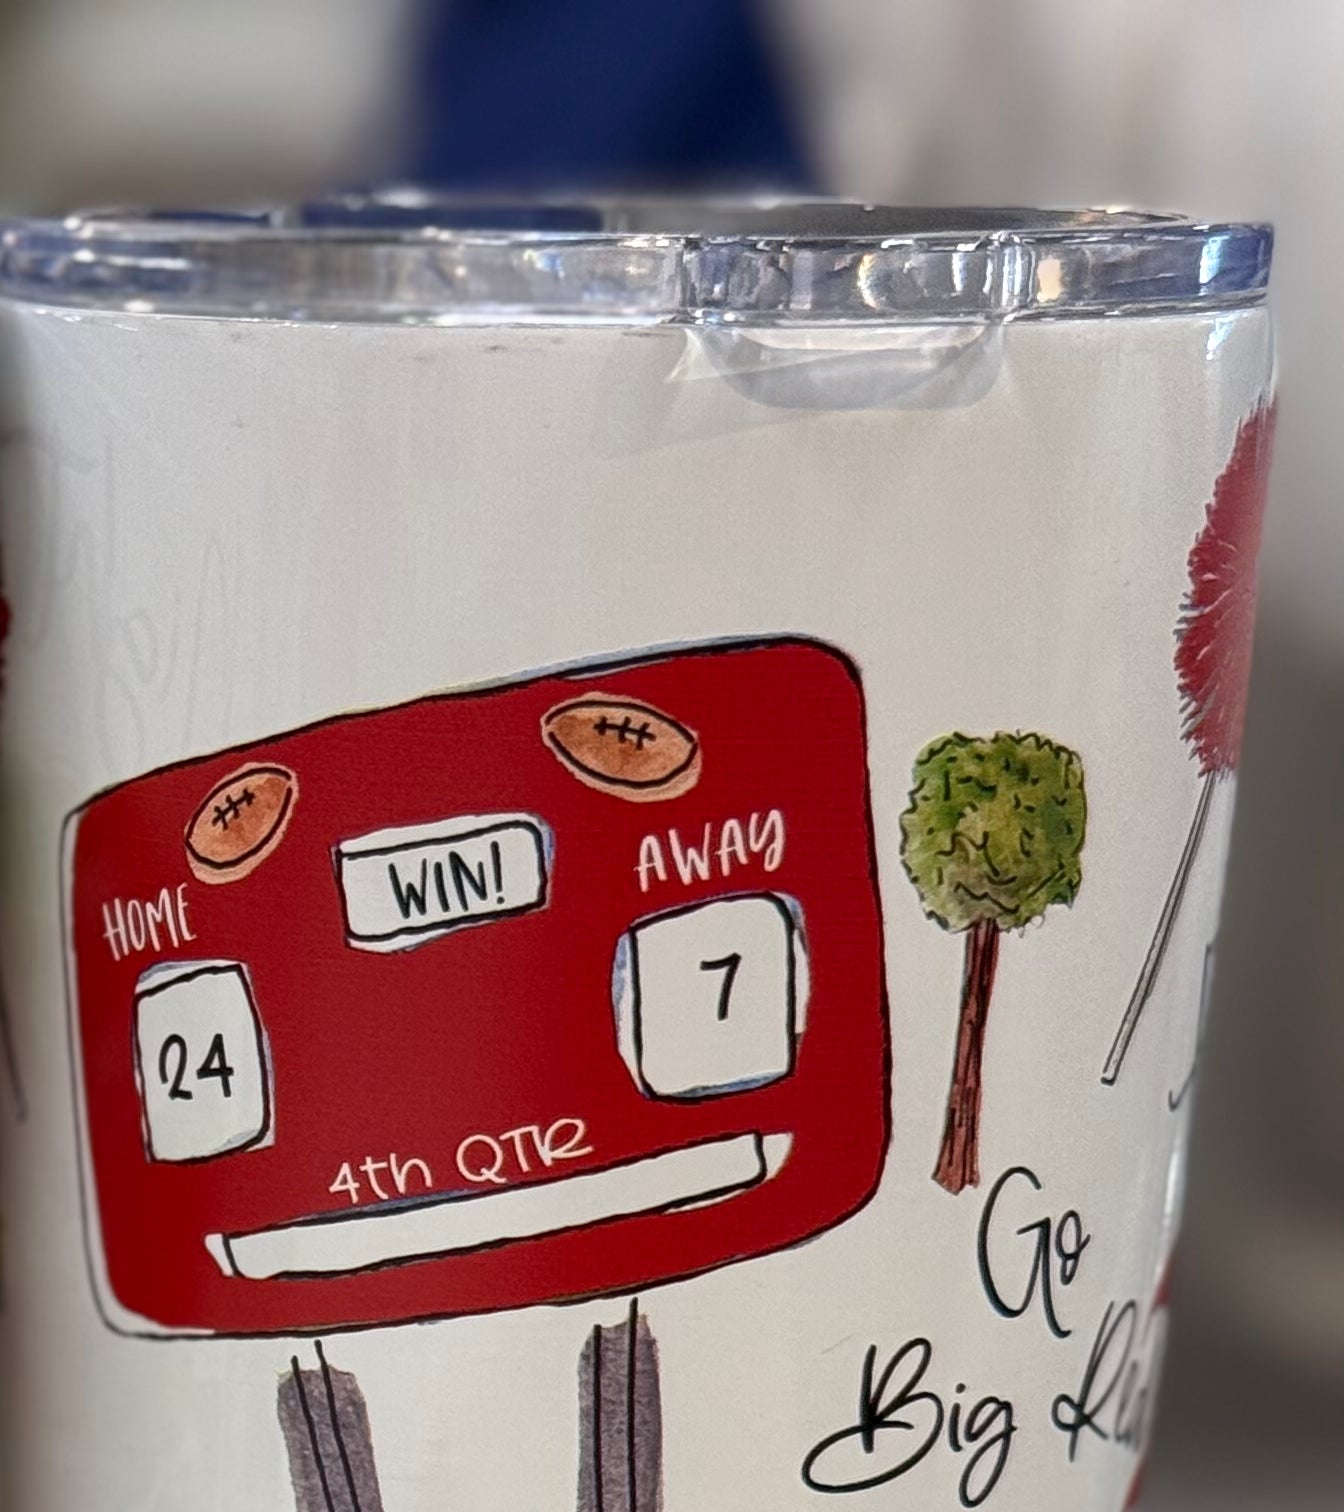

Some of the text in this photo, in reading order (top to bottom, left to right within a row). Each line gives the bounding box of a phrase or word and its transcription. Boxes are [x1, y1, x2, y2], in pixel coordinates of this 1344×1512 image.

[387, 839, 507, 920] WIN!
[632, 807, 787, 892] AWAY
[101, 882, 199, 962] HOME
[698, 952, 743, 1023] 7
[157, 1032, 235, 1102] 24
[328, 1118, 595, 1204] 4th QTR
[977, 1166, 1091, 1338] Go
[801, 1337, 1018, 1508] Big
